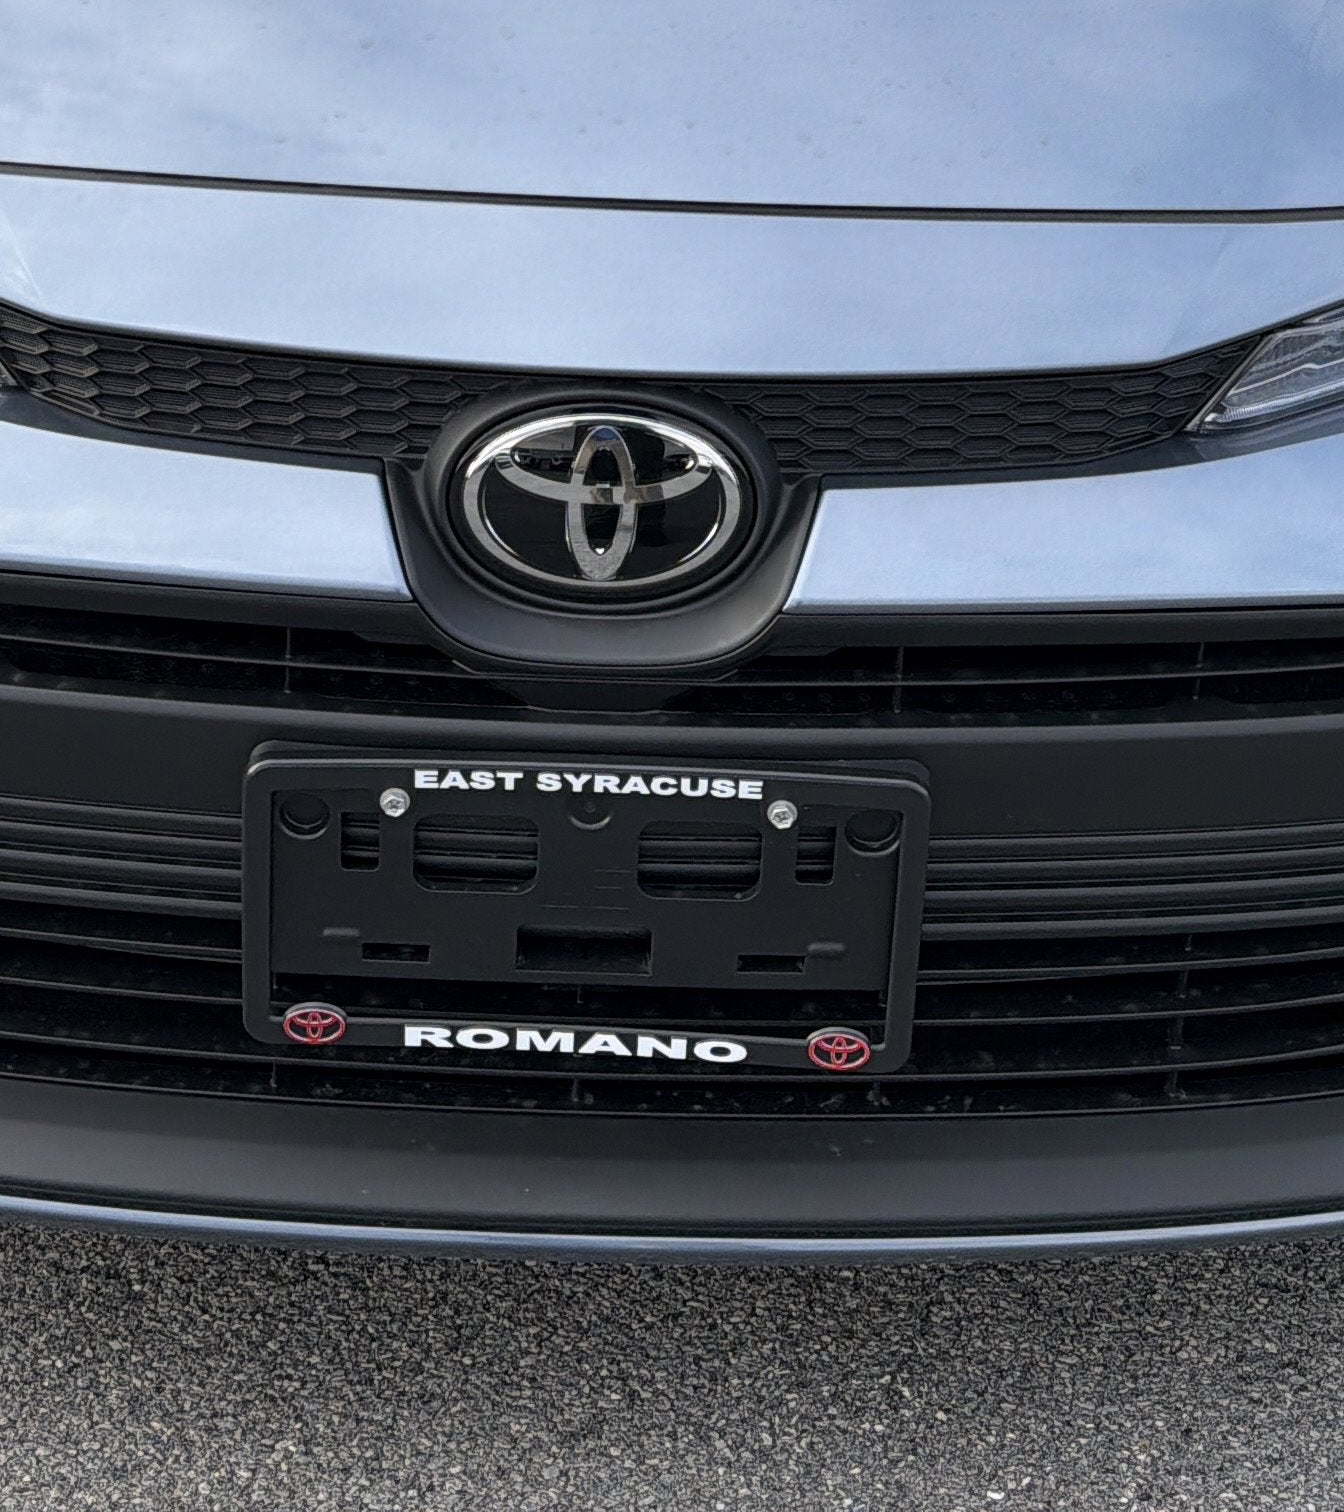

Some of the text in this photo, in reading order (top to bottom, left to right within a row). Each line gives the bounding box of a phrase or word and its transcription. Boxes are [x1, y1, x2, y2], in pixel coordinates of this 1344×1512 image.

[414, 768, 764, 800] EAST SYRACUSE
[404, 1025, 748, 1064] ROMANO
